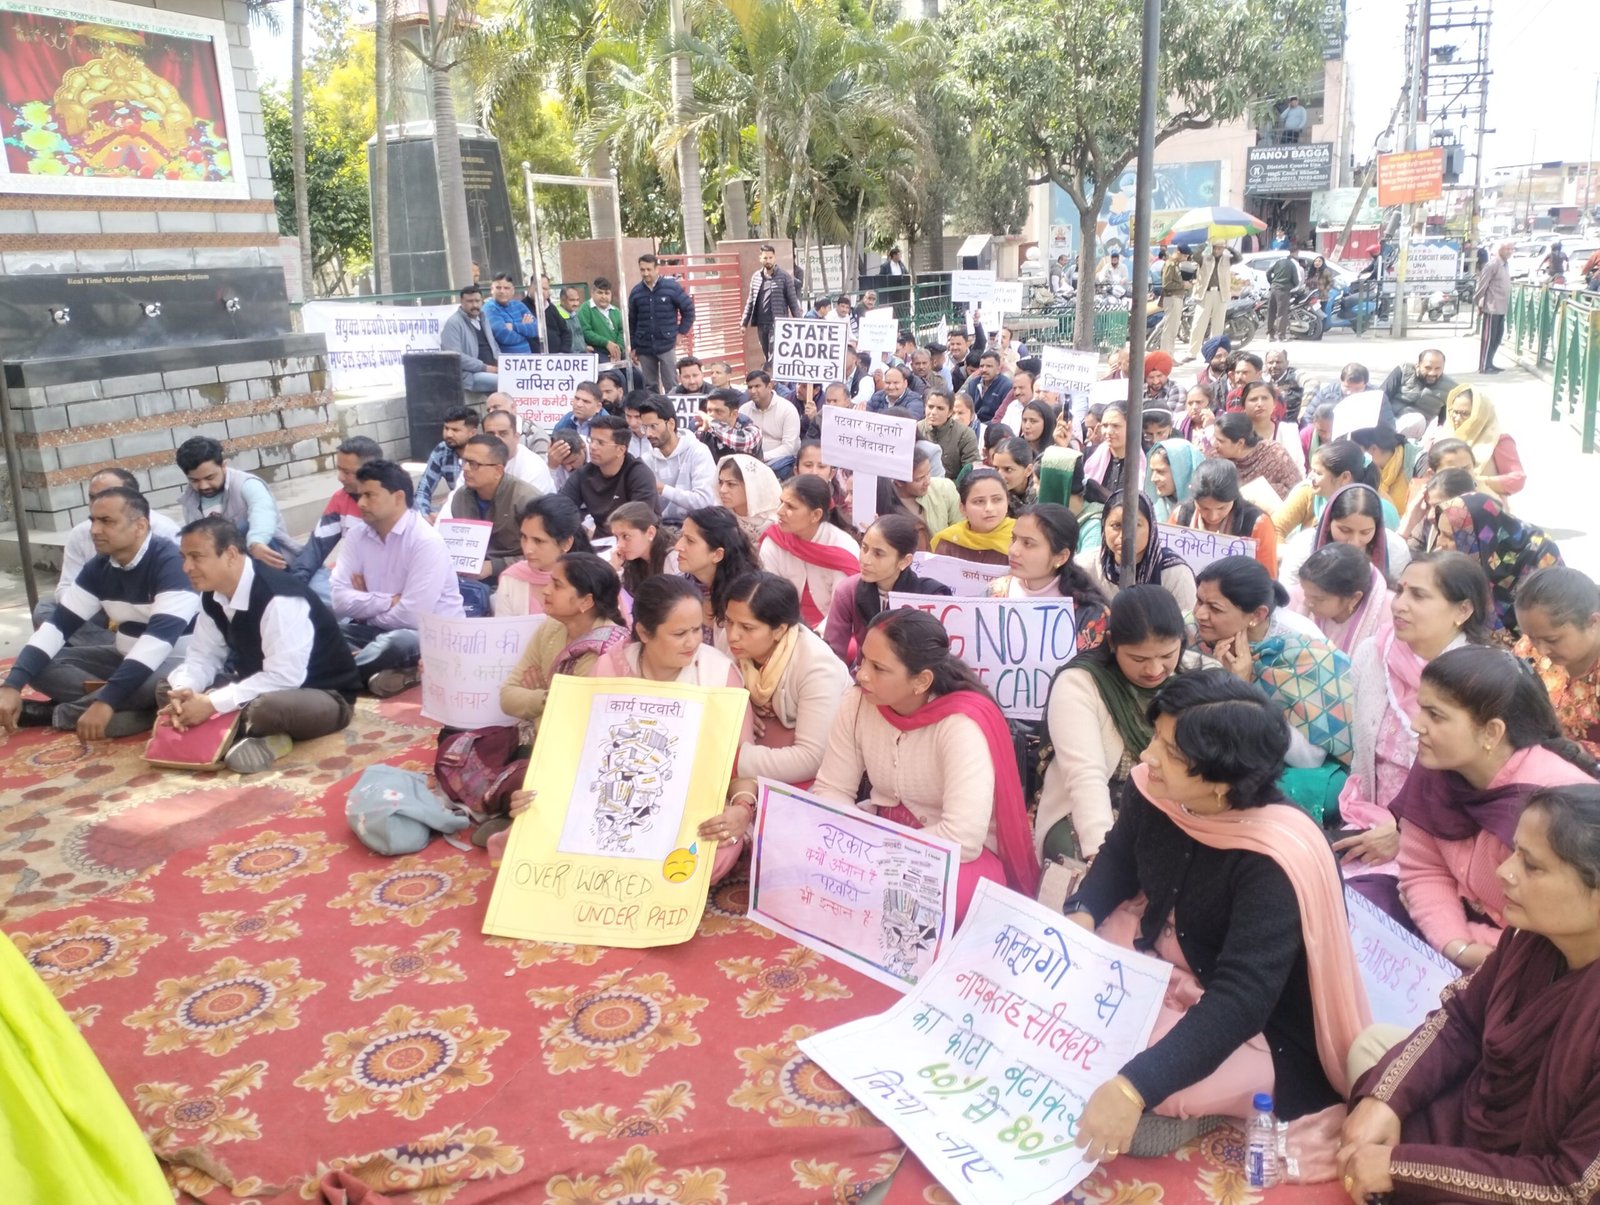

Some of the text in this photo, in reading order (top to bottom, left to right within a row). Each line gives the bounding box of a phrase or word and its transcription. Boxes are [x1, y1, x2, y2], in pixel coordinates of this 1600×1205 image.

[1250, 149, 1329, 160] MANOJ BAGGA
[126, 275, 150, 283] Quality
[151, 274, 187, 282] Monitoring
[782, 323, 839, 341] STATE
[778, 341, 840, 360] CADRE
[504, 359, 588, 371] STATE CADRE
[777, 359, 839, 380] वापिस हो
[516, 374, 575, 391] वापिस लो
[541, 394, 568, 407] कमेटी
[834, 415, 903, 438] पटवार कानूनगो
[838, 433, 896, 455] संघ जिंदाबाद
[962, 570, 980, 581] कार्य
[496, 629, 520, 654] की
[975, 605, 1028, 665] NO
[1033, 605, 1076, 663] TO
[996, 667, 1052, 709] CAD
[610, 698, 681, 717] कार्य पटवारी
[818, 823, 882, 864] सरकार
[515, 862, 653, 902] OVER WORKED
[811, 873, 870, 903] पटवारी
[799, 886, 815, 905] भी
[577, 904, 689, 930] UNDER PAID
[995, 924, 1131, 1028] कानूनगो से
[912, 1000, 952, 1035] का
[948, 1012, 1003, 1071] कोटा
[916, 1061, 988, 1101] 60%
[998, 1114, 1078, 1167] 80%
